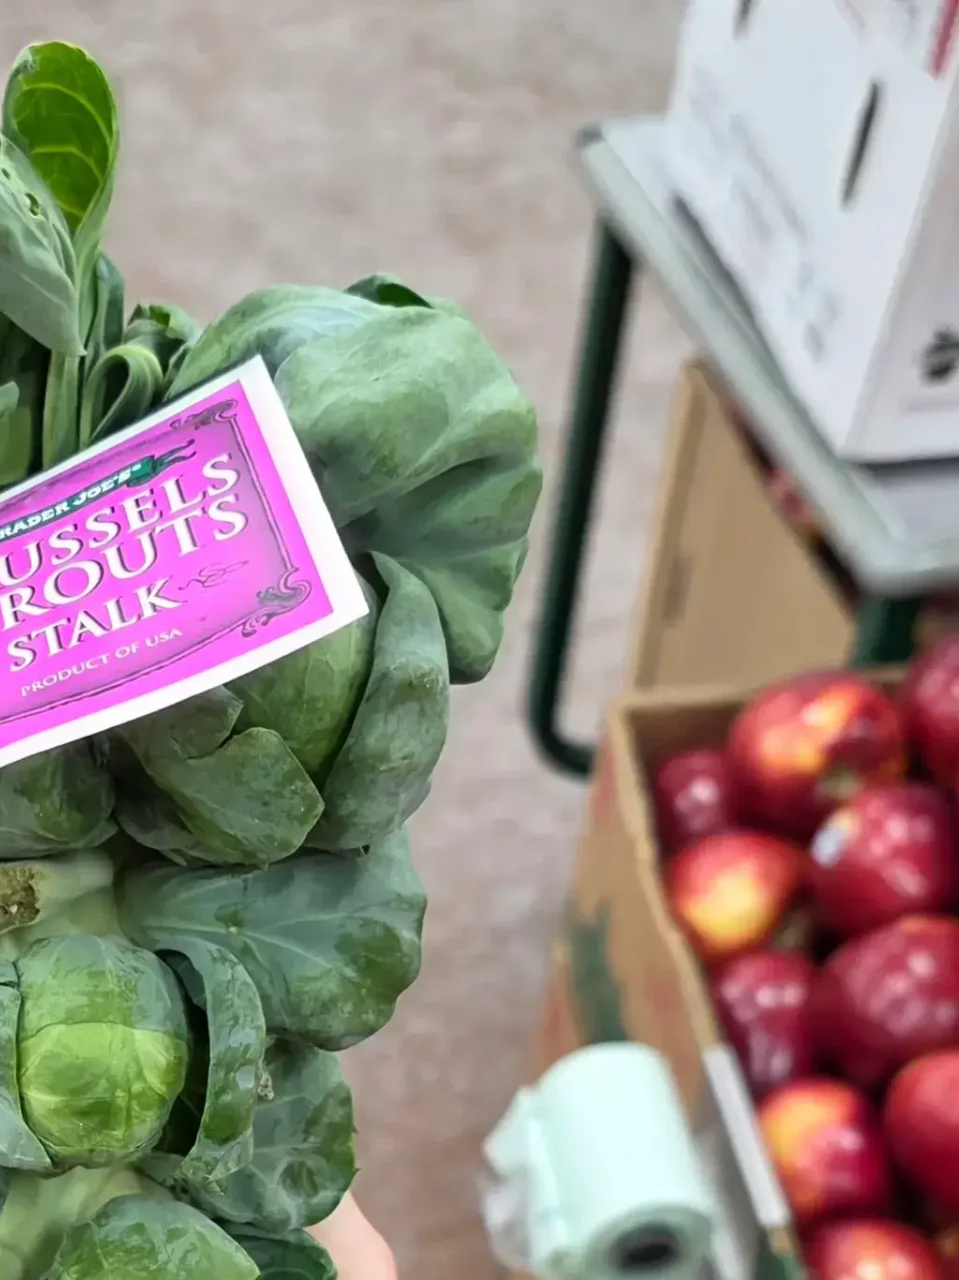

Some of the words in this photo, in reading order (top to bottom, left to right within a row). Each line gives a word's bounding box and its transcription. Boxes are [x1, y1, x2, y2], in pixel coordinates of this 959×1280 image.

[72, 467, 133, 506] JOE'S
[7, 577, 182, 673] STALK
[20, 653, 110, 697] PRODUCT
[114, 640, 141, 657] OF
[145, 628, 182, 650] USA
